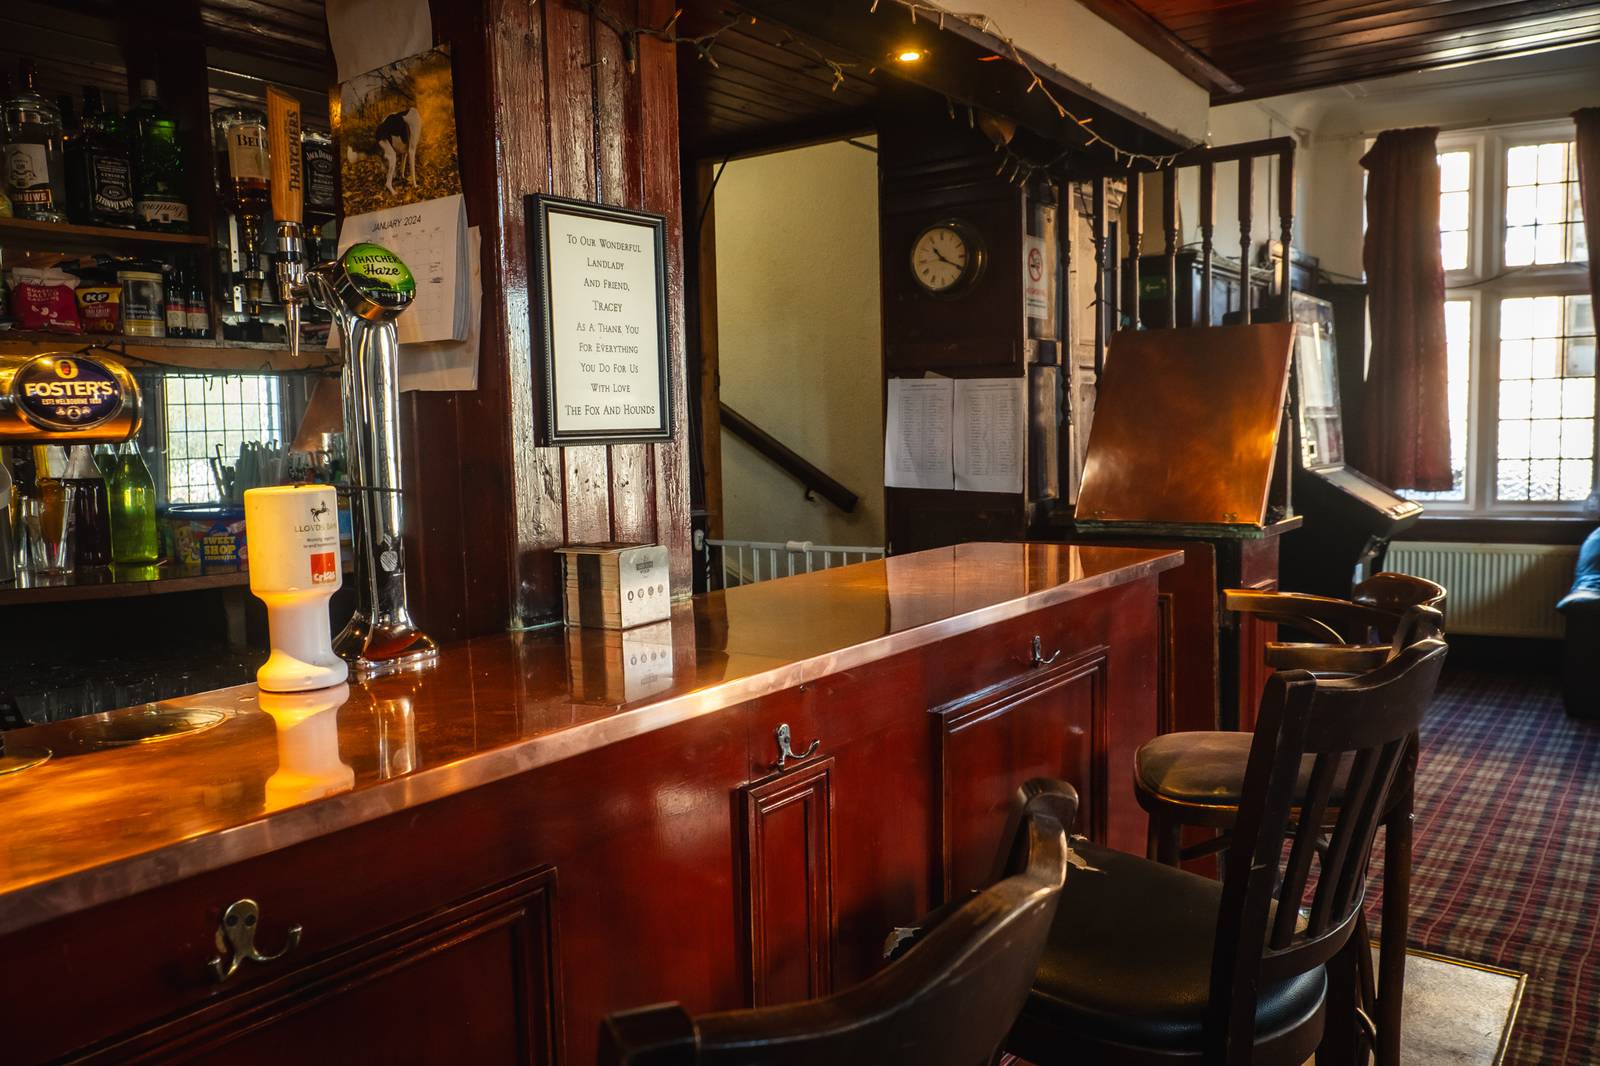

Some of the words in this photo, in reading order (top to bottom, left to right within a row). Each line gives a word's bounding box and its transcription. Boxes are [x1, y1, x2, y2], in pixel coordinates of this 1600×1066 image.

[287, 109, 301, 192] THATCHERS
[371, 219, 402, 233] JANUARY
[404, 215, 422, 226] 2024
[363, 263, 400, 276] Haze
[86, 293, 107, 301] KP
[588, 323, 595, 332] A
[24, 381, 113, 397] FOSTER'S
[203, 536, 236, 544] SWEET
[204, 545, 236, 555] SHOP
